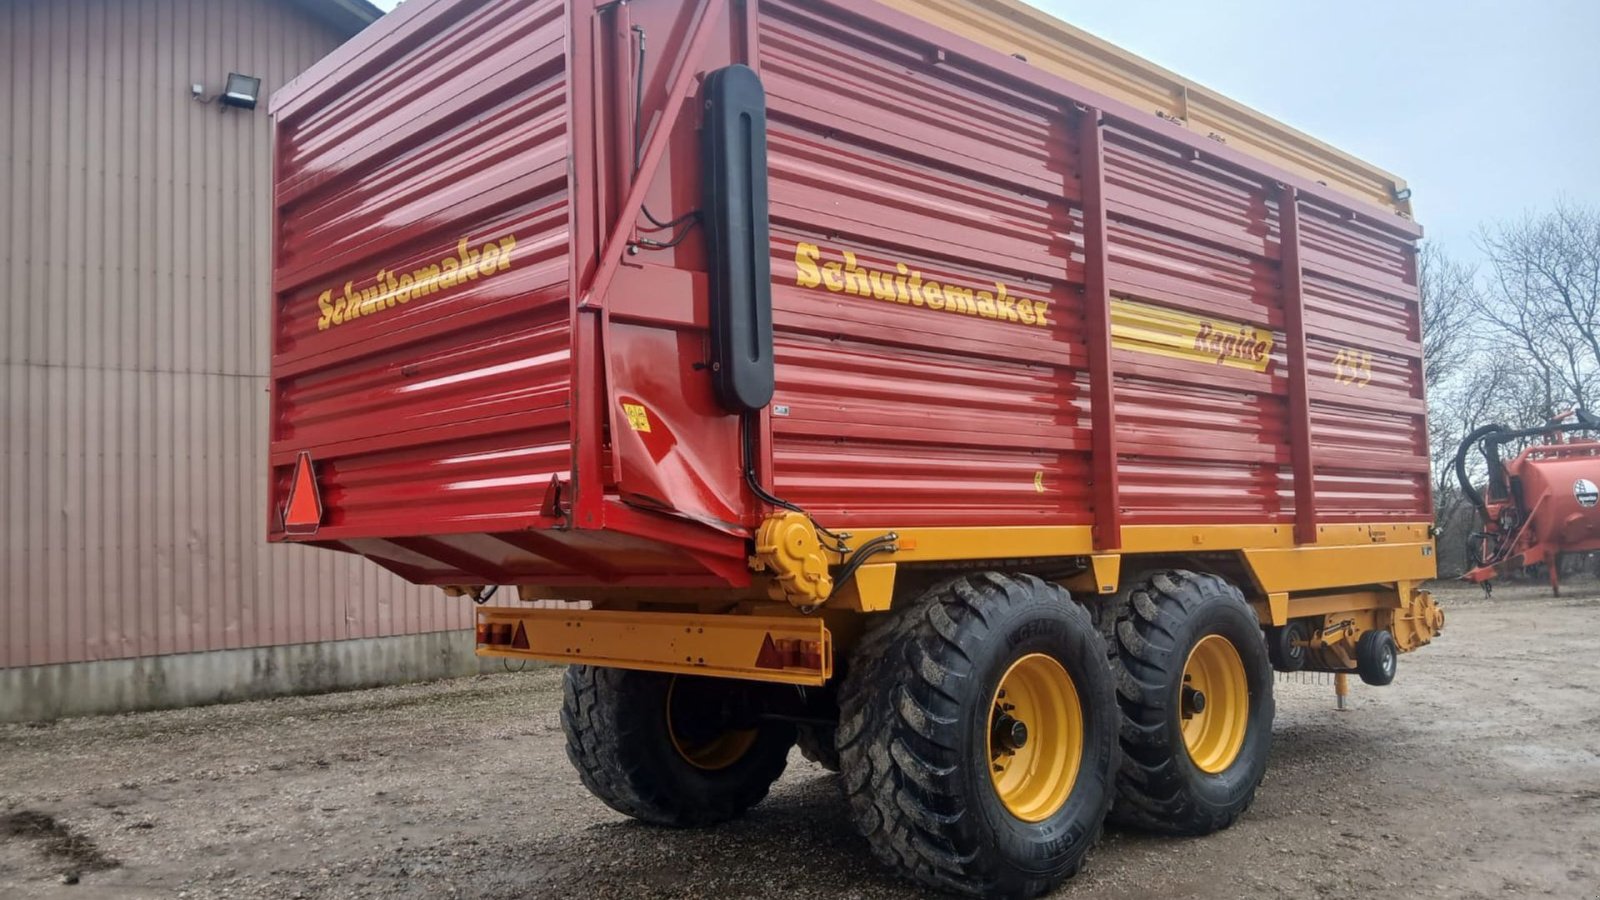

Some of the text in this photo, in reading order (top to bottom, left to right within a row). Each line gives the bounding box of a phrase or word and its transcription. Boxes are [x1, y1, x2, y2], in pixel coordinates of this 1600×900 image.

[318, 234, 517, 331] Schuitemaker
[794, 242, 1048, 327] Schuitemaker
[1193, 321, 1268, 366] Rapide
[1331, 349, 1372, 388] 155
